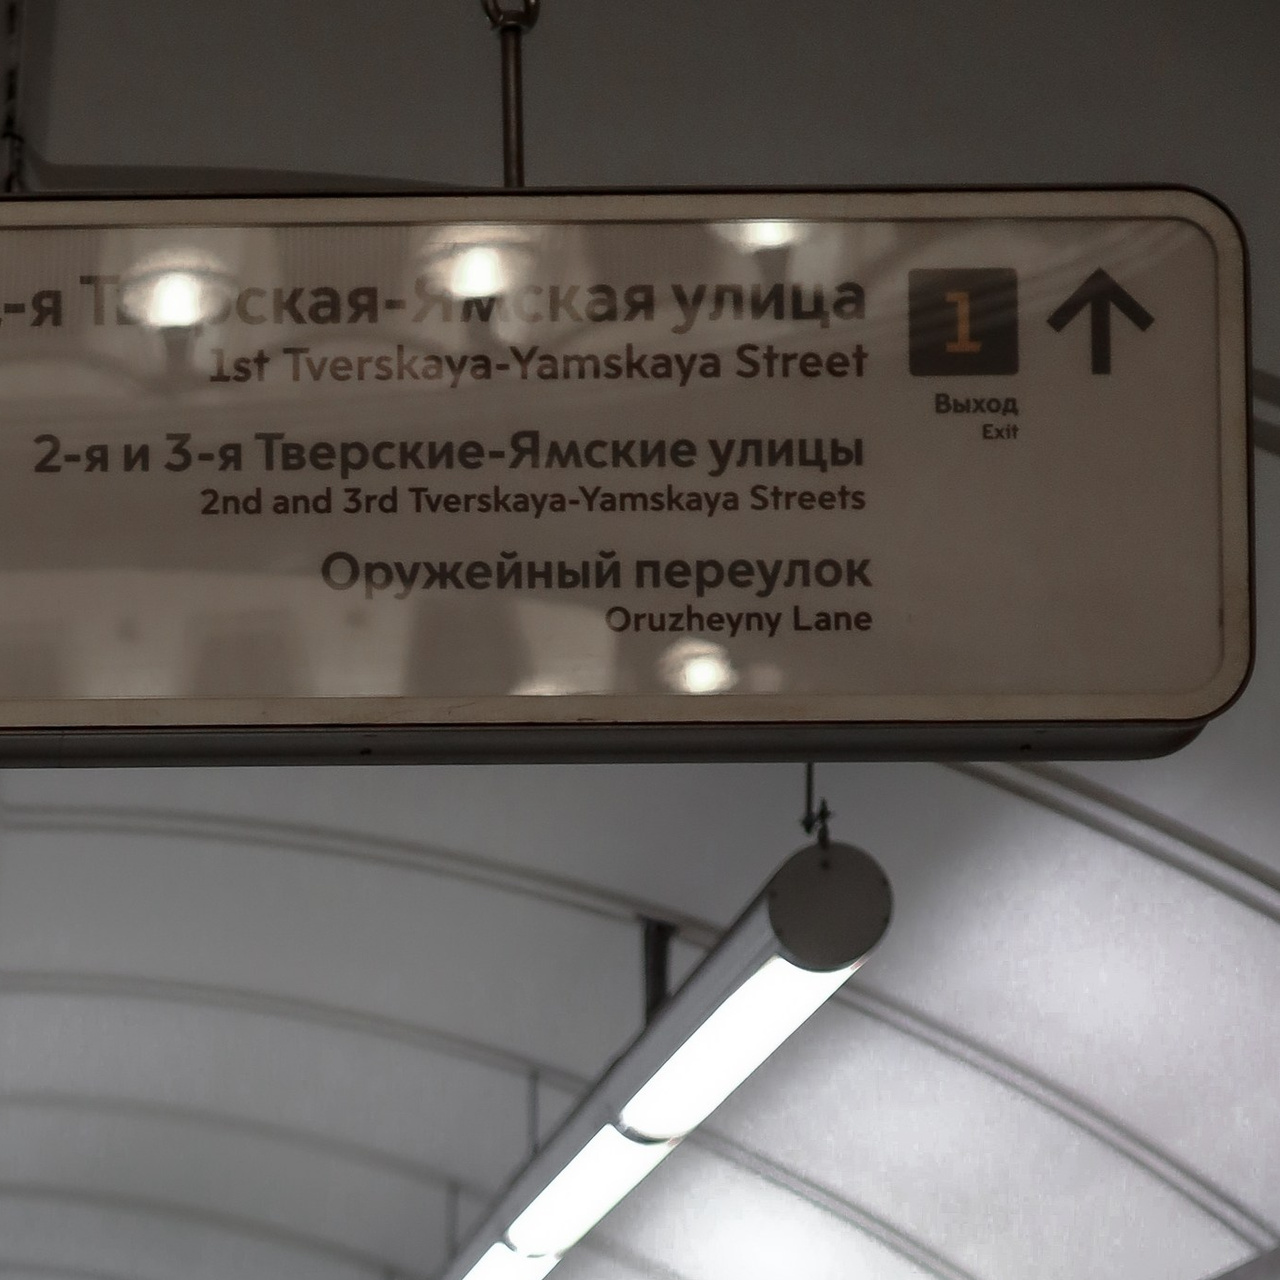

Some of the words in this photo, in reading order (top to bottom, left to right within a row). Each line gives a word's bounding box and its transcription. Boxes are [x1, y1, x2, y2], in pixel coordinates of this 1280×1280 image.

[670, 280, 867, 335] улица
[944, 290, 983, 354] 1
[209, 346, 269, 383] 1st
[283, 343, 723, 388] Tverskaya-Yamskaya
[735, 343, 869, 379] Street
[934, 393, 1020, 418] Выход
[981, 422, 1020, 441] Exit
[32, 432, 110, 474] 2-я
[121, 441, 150, 472] и
[163, 432, 243, 473] 3-я
[254, 429, 699, 480] Тверские-Ямские
[708, 434, 865, 478] улицы
[200, 487, 262, 516] 2nd
[272, 487, 332, 515] and
[343, 486, 399, 515] 3rd
[408, 484, 740, 519] Tverskaya-Yamskaya
[749, 484, 867, 514] Streets
[321, 551, 623, 600] Оружейный
[635, 554, 872, 598] переулок
[605, 605, 781, 638] Oruzheyny
[791, 605, 873, 634] Lane
